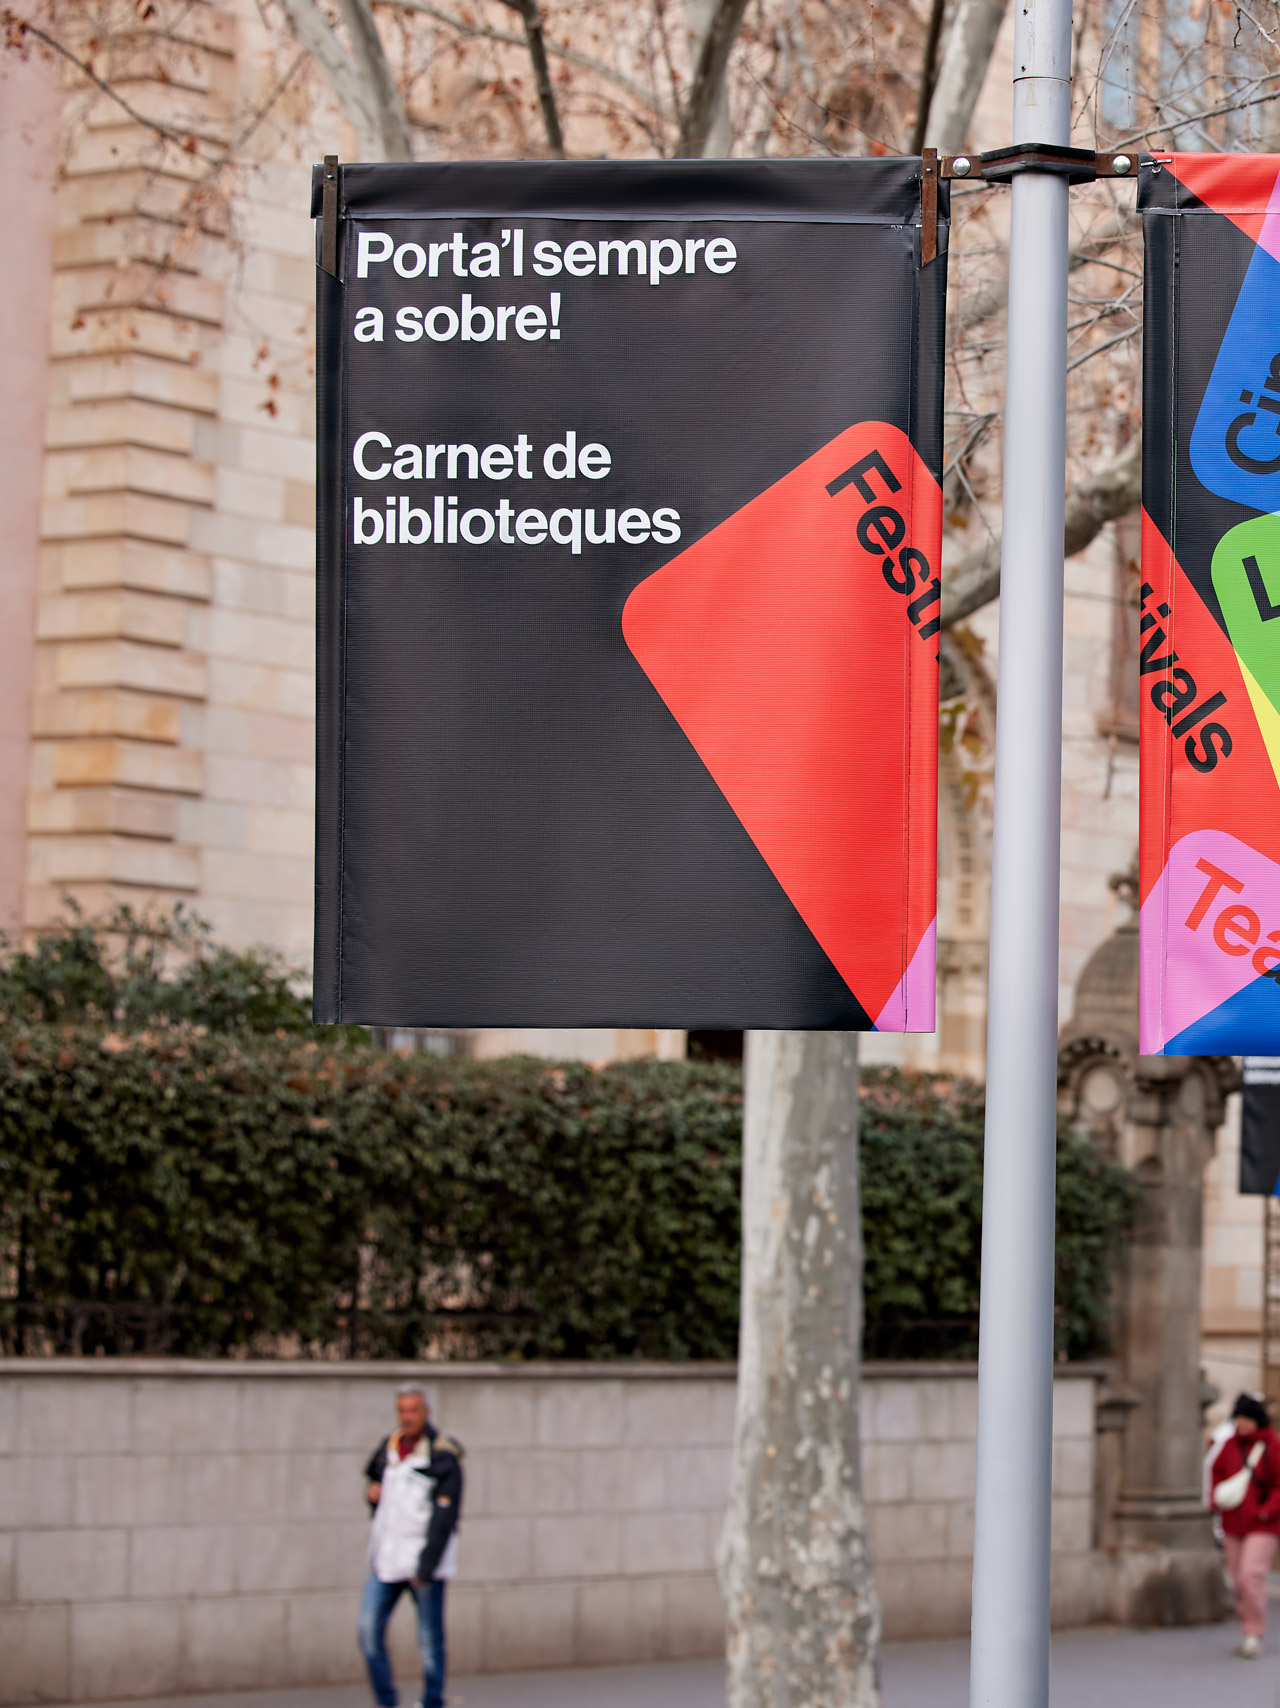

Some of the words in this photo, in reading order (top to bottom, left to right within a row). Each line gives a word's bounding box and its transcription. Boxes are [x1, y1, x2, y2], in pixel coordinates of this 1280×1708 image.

[356, 229, 524, 279] Porta'l
[532, 237, 738, 285] sempre
[353, 307, 384, 342] a
[394, 292, 562, 342] sobre!
[352, 431, 533, 481] Carnet
[543, 431, 612, 480] de
[353, 496, 682, 554] biblioteques
